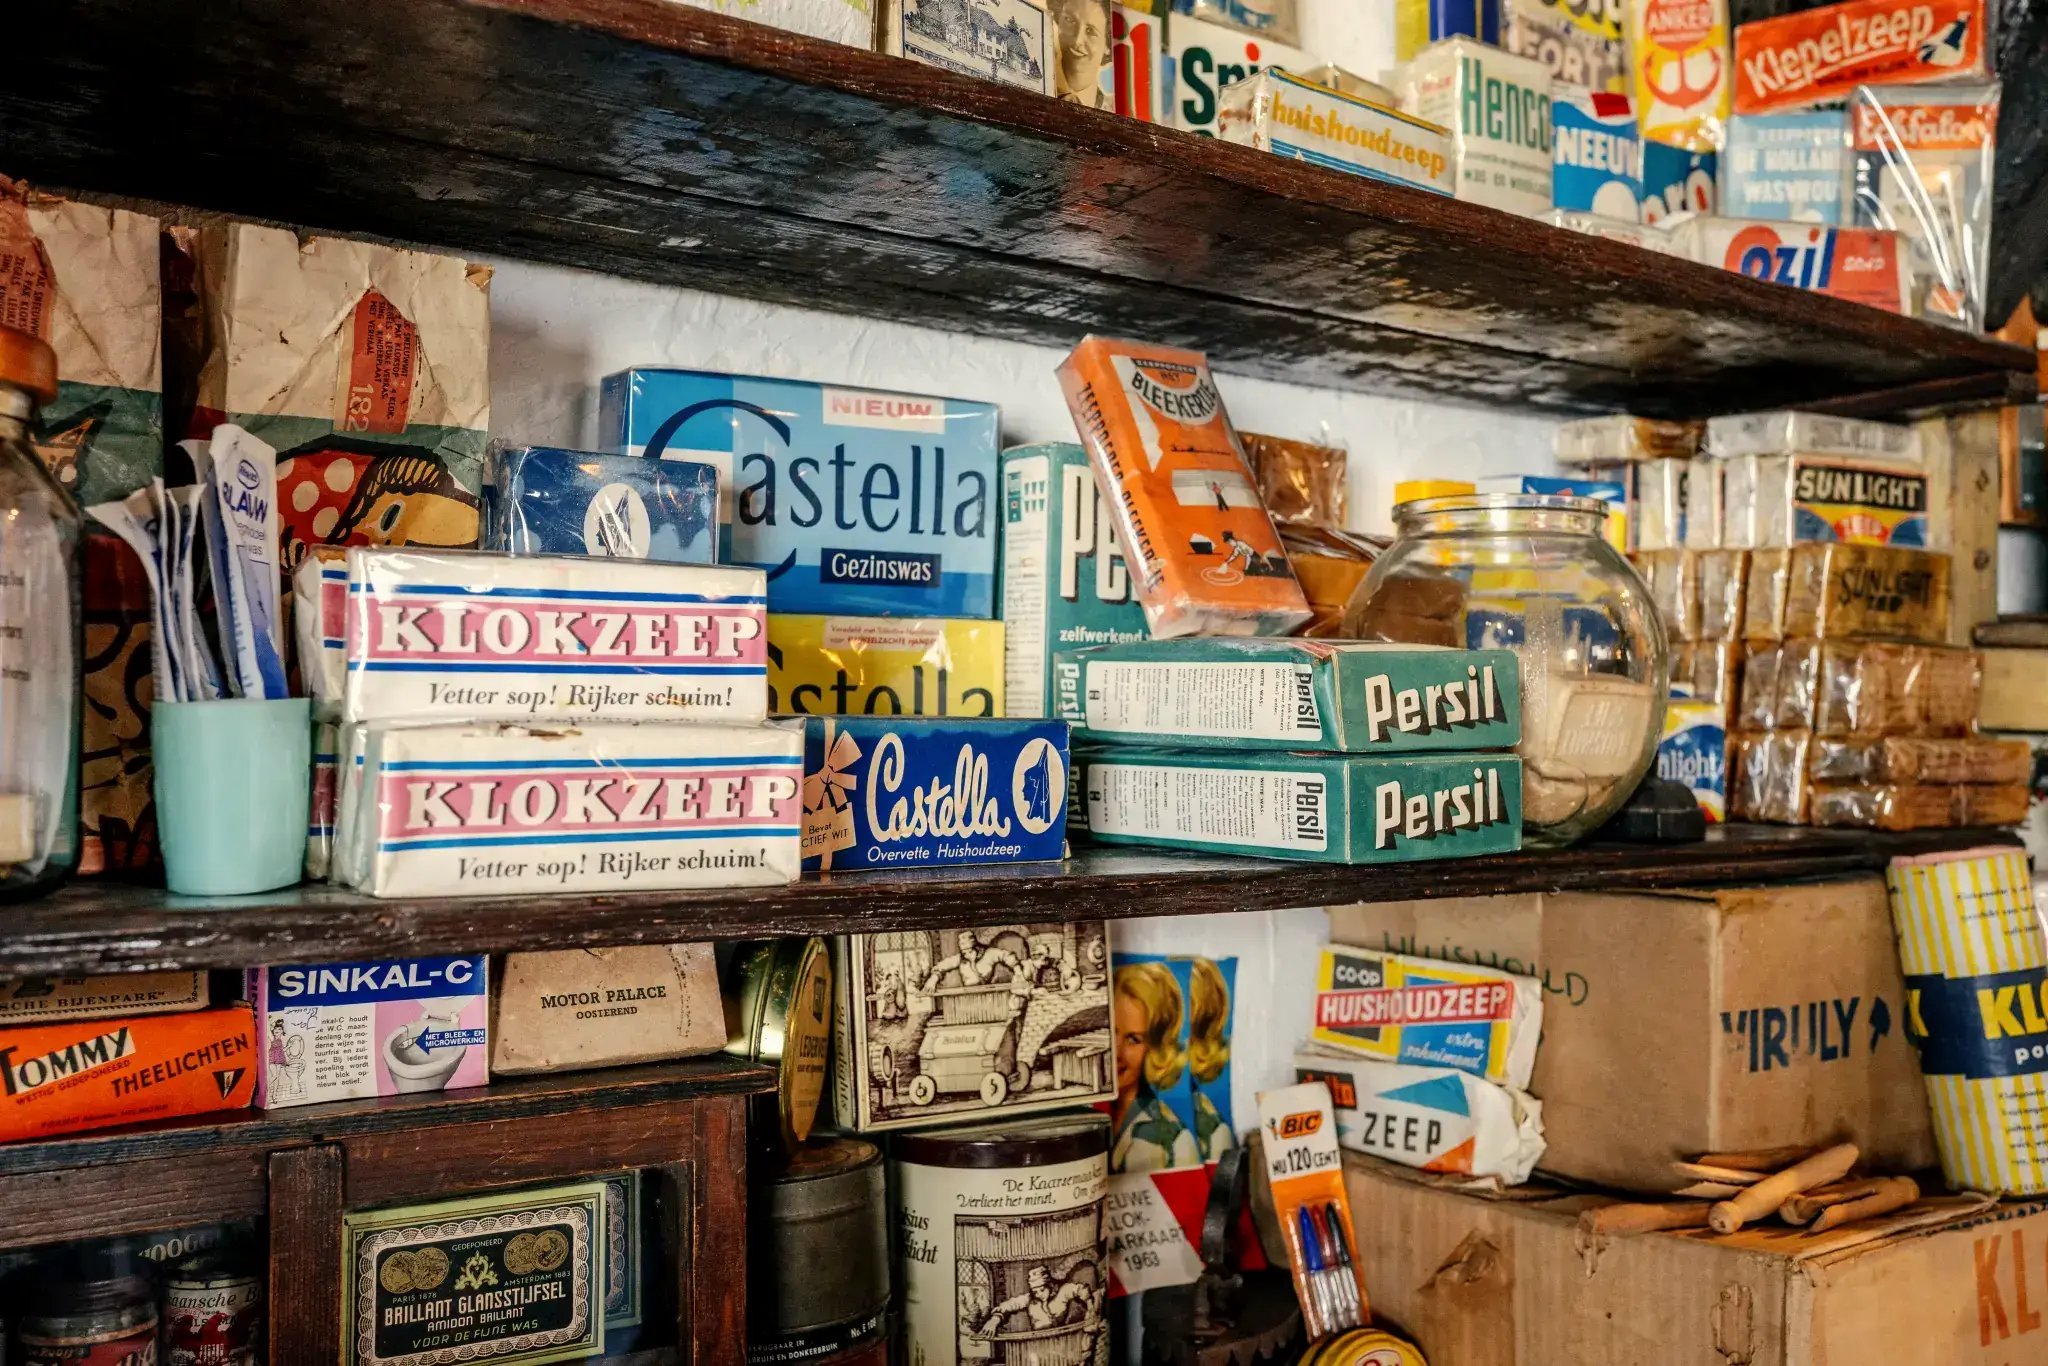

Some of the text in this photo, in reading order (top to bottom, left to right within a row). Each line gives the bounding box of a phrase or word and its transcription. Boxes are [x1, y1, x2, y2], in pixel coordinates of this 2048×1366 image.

[1743, 5, 1934, 98] Klepelzeep
[1462, 57, 1550, 154] Henco
[1272, 90, 1446, 179] huishoudzeep
[366, 320, 376, 355] VERHAAL
[392, 342, 402, 378] KLOKSOP
[831, 395, 932, 419] NIEUW
[1799, 469, 1923, 508] SUNLIGHT
[830, 551, 932, 583] Gezinswas
[377, 606, 762, 657] KLOKZEEP
[1059, 625, 1143, 643] zelfwerkend
[429, 683, 733, 712] Vetter sop! Rijker schuim!
[1057, 662, 1087, 730] Persil
[1295, 672, 1320, 730] Persil
[1364, 665, 1499, 742] Persil
[1658, 748, 1717, 788] nlight
[866, 732, 1011, 843] Castella
[405, 776, 798, 829] KLOKZEEP
[1296, 782, 1324, 841] Persil
[1375, 767, 1500, 849] Persil
[801, 829, 849, 848] CTIEF WIT
[808, 822, 832, 835] Bevat
[458, 848, 766, 882] Vetter sop! Rijker schuim!
[867, 843, 1022, 863] Overvette Huishoudzeep
[277, 959, 474, 997] SINKAL-C
[0, 1000, 50, 1011] SCHE
[540, 985, 667, 1009] MOTOR PALACE
[1321, 981, 1507, 1024] HUISHOUDZEEP
[320, 1015, 369, 1025] nkal-C houdt
[576, 1005, 638, 1020] OOSTEREND
[327, 1024, 345, 1032] W.C.
[425, 1033, 440, 1041] MET
[444, 1030, 470, 1039] BLEEK-
[315, 1049, 339, 1057] tuurfris
[337, 1040, 354, 1048] wijze
[425, 1036, 485, 1048] MICROWERKING
[111, 1033, 249, 1098] THEELICHTEN
[315, 1065, 344, 1073] spoeling
[335, 1071, 350, 1079] blok
[15, 1058, 131, 1106] WETTIG GEDEPONEERD
[341, 1078, 362, 1086] actief.
[1363, 1112, 1442, 1154] ZEEP
[1288, 1149, 1312, 1171] 120
[1005, 1195, 1022, 1207] het
[1107, 1189, 1153, 1211] EUWE
[905, 1207, 930, 1231] lsius
[451, 1237, 503, 1252] GEDEPONEERD
[904, 1239, 938, 1264] licht
[1124, 1250, 1161, 1272] 1963
[503, 1272, 552, 1287] AMSTERDAM
[1974, 1224, 2048, 1348] KL
[168, 1286, 260, 1309] aansche B
[384, 1280, 567, 1327] BRILLANT GLANSSTIJFSEL
[392, 1292, 416, 1304] PARIS
[427, 1306, 525, 1333] AMIDON BRILLANT
[412, 1319, 539, 1349] VOOR DE FIJNE WAS
[777, 1342, 838, 1361] EN DONKERBRUIN
